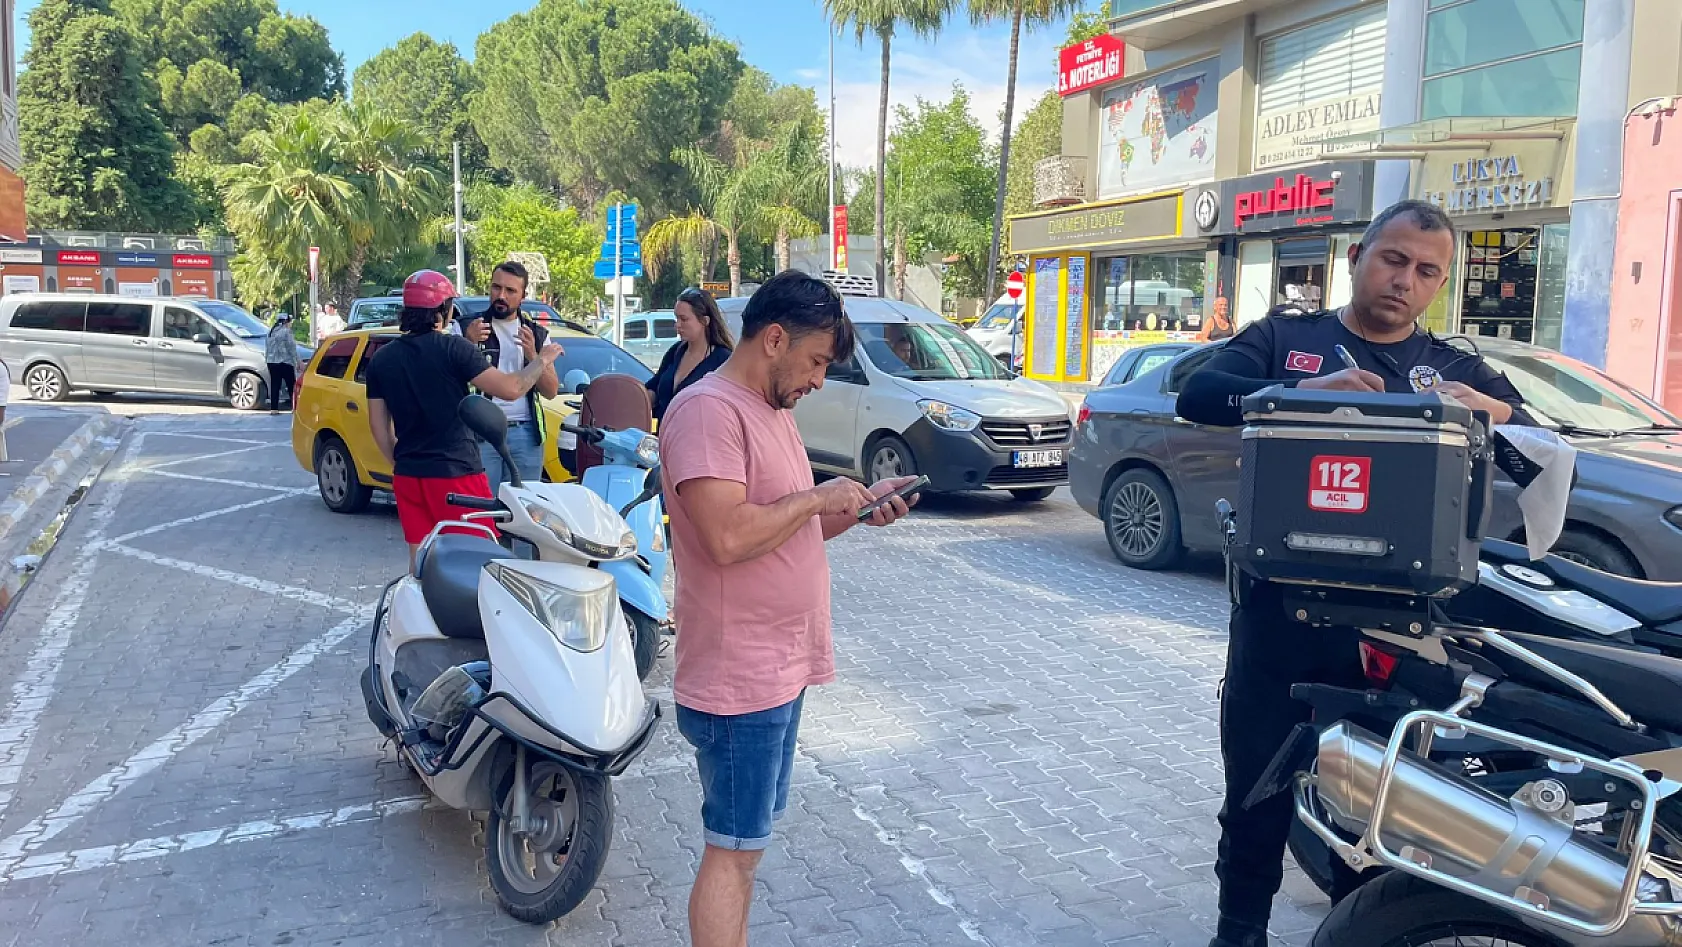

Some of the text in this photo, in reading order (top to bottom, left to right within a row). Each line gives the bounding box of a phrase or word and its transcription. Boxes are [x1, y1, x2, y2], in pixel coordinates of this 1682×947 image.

[1060, 49, 1120, 91] 3. NOTERLİĞİ
[1261, 108, 1319, 139] ADLEY
[1452, 153, 1521, 183] LİKYA
[1234, 173, 1335, 229] public
[1446, 176, 1552, 211] MERKEZİ
[1318, 461, 1361, 488] 112
